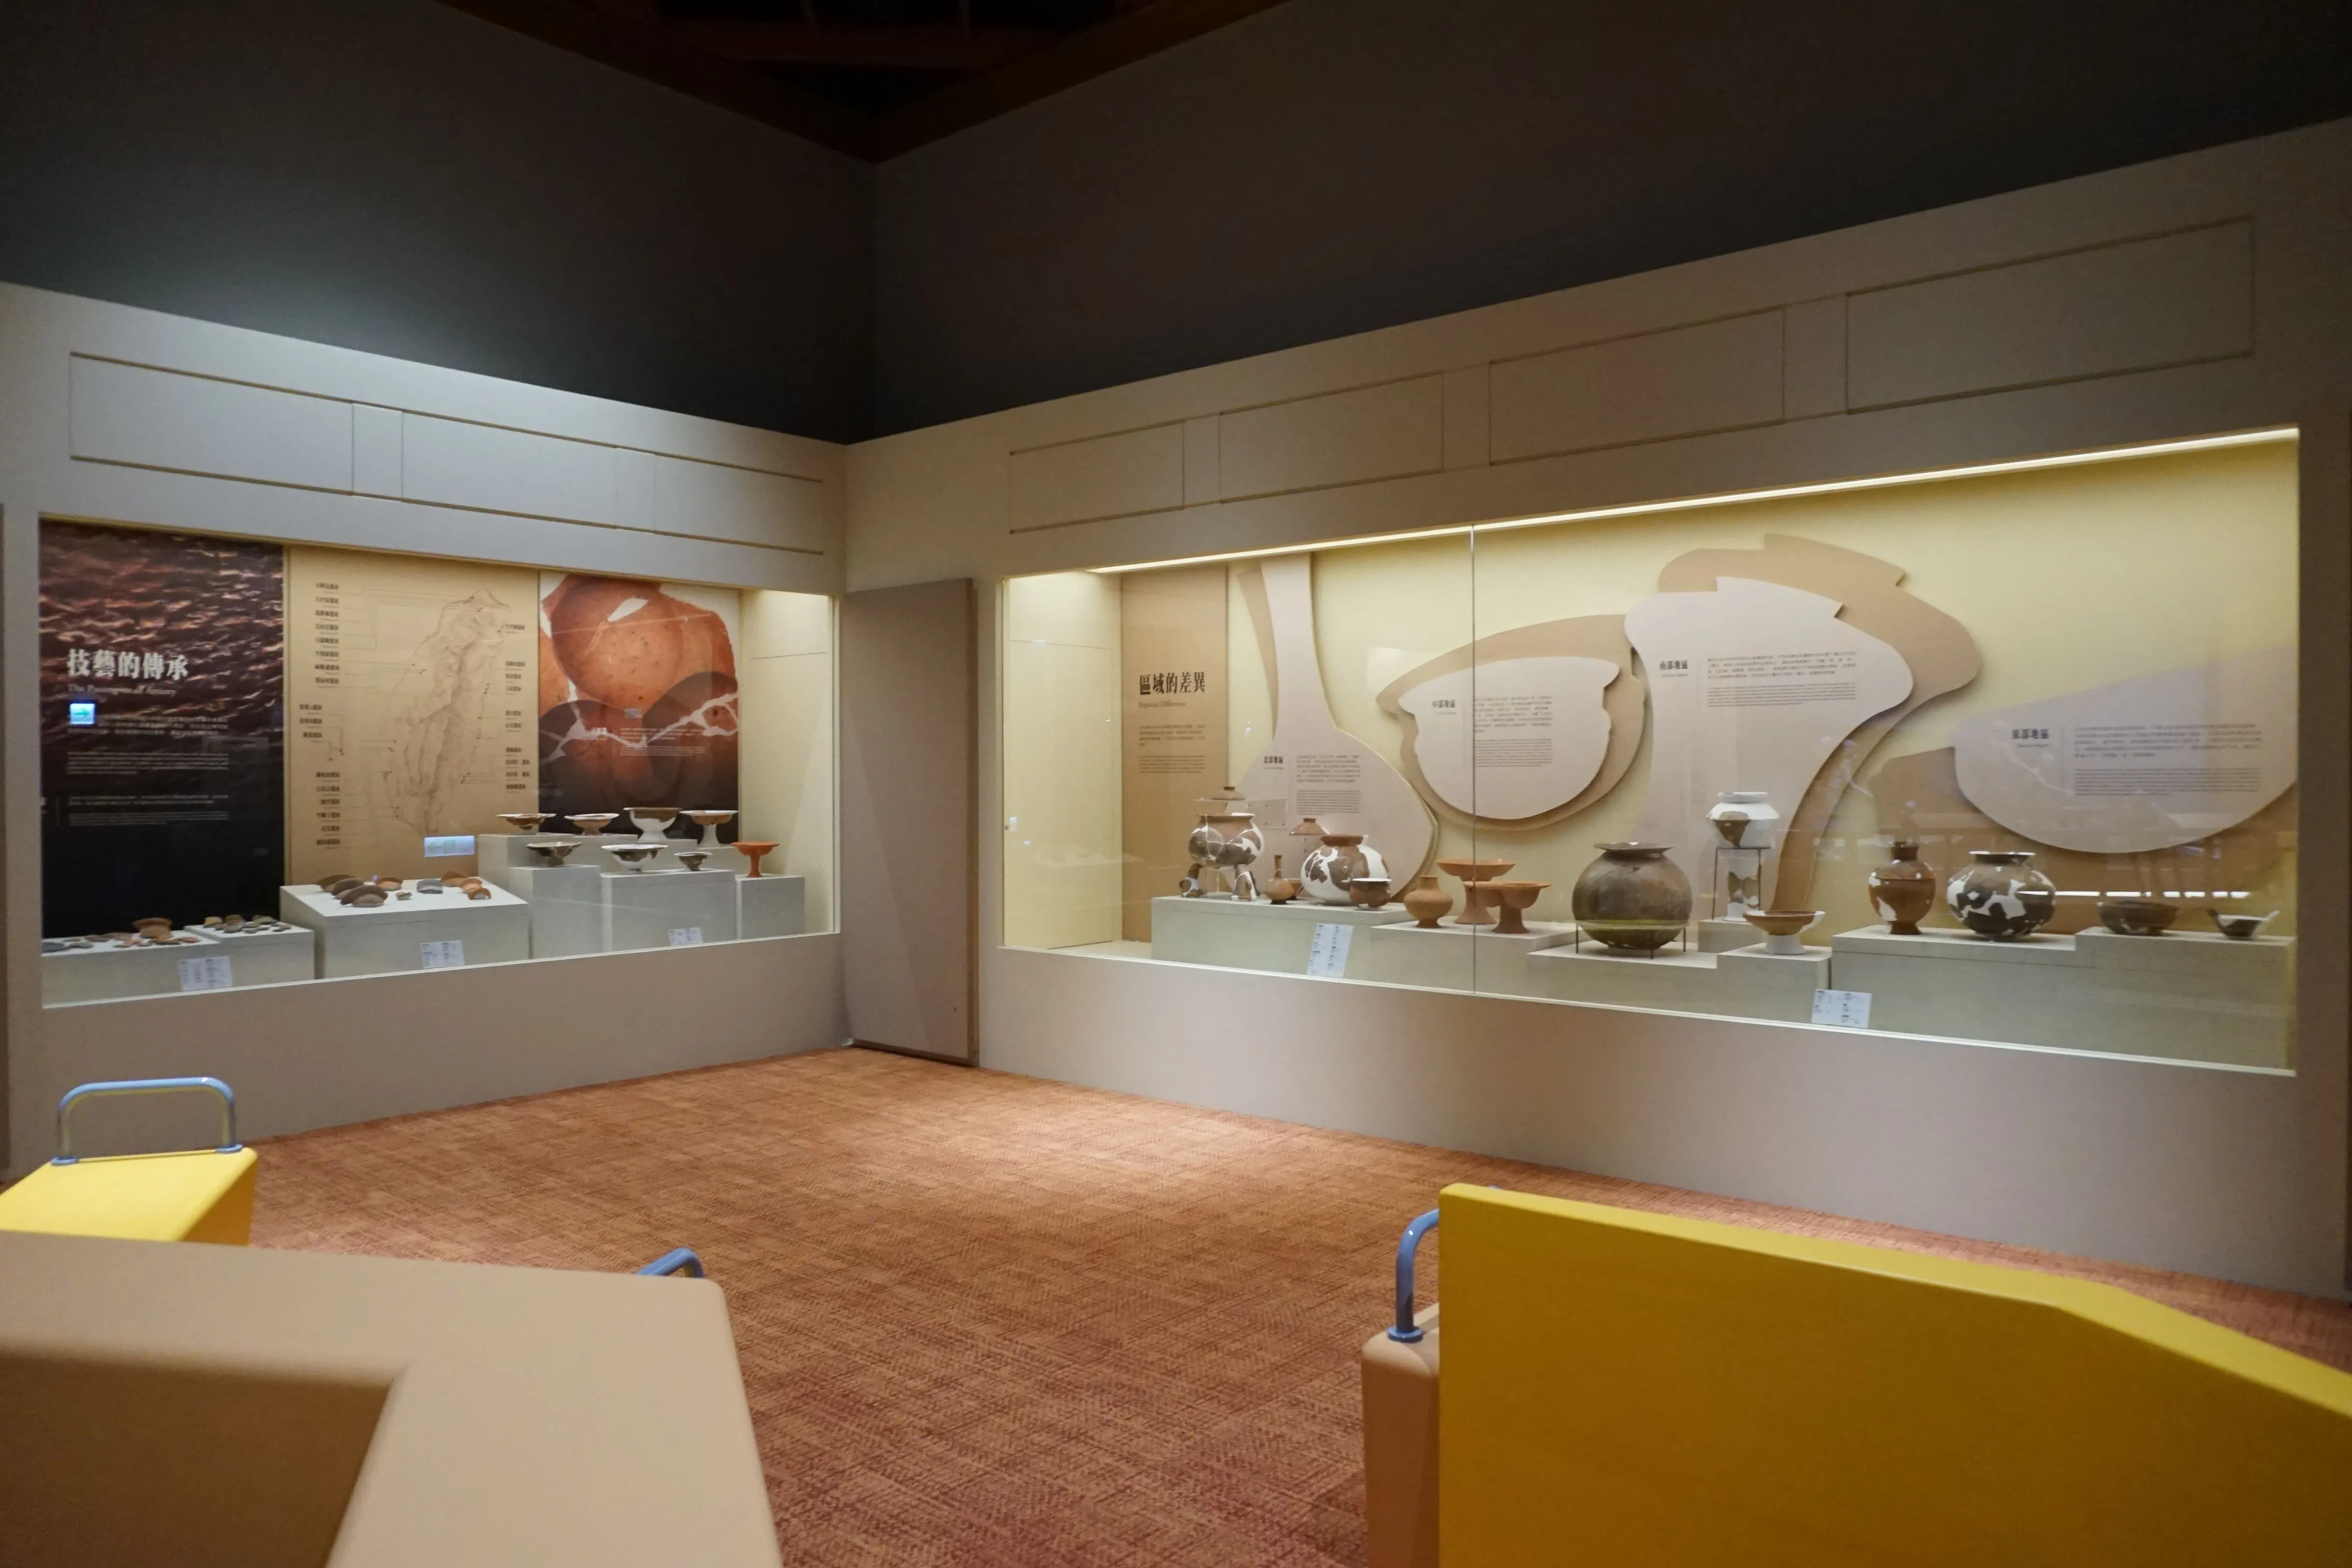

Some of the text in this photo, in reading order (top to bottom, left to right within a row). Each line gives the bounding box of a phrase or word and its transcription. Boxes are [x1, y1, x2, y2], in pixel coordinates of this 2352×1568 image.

[67, 648, 189, 680] 技藝的傳承
[1139, 671, 1206, 695] 區域的差異
